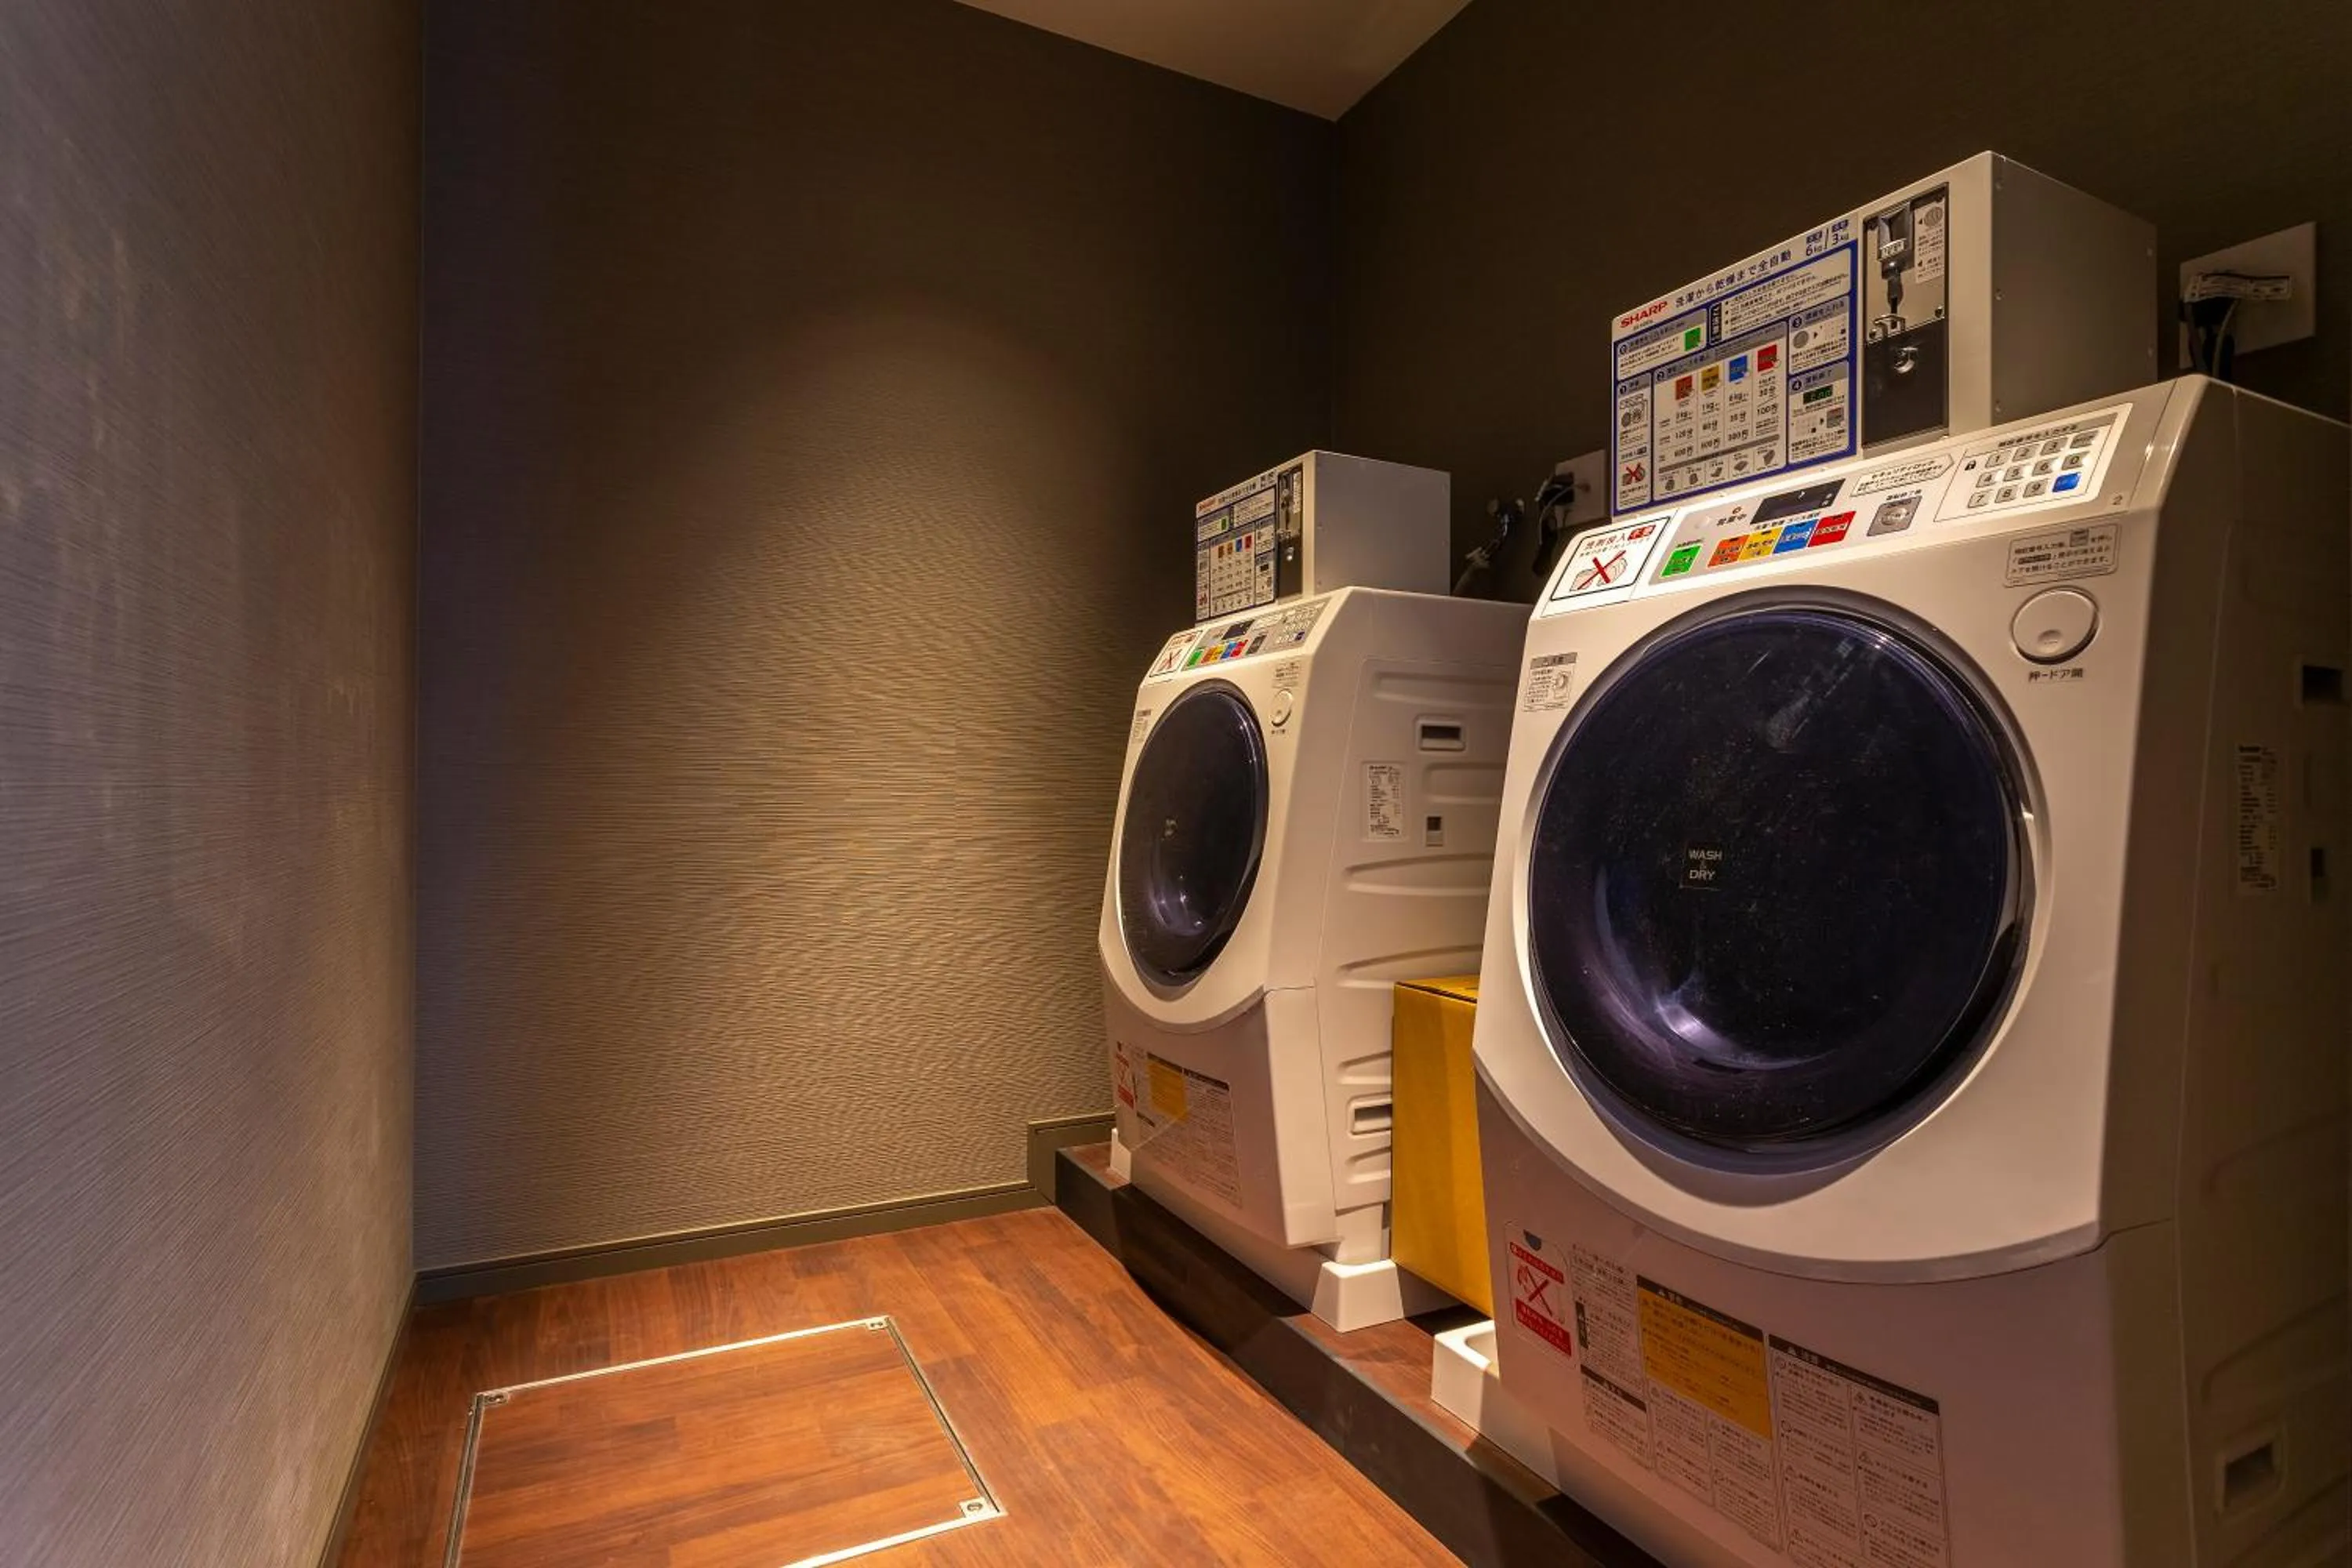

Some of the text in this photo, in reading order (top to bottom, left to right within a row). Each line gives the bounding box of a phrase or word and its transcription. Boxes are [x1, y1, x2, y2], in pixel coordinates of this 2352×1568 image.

[1619, 301, 1668, 328] SHARP
[1688, 849, 1723, 861] WASH
[1690, 869, 1716, 880] DRY
